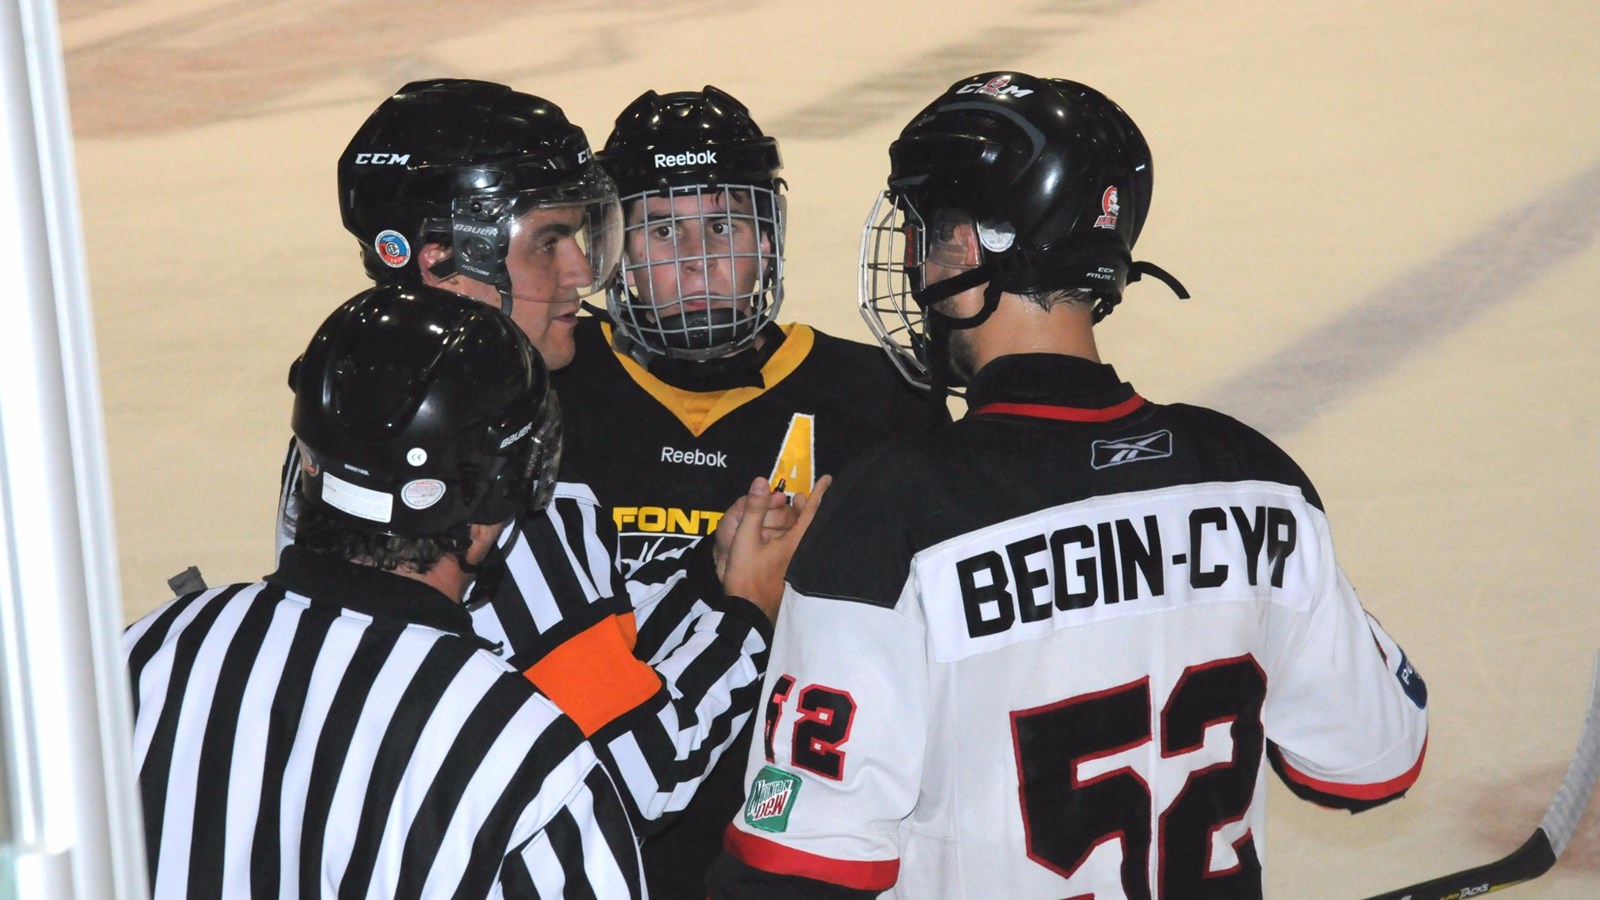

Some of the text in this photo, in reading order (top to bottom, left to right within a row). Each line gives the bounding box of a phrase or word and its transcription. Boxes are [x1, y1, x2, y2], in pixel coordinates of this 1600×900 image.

[956, 83, 1034, 98] CM
[355, 153, 410, 166] CCM
[654, 150, 717, 168] Reebok
[661, 446, 727, 469] Reebok
[768, 412, 815, 505] A
[955, 506, 1297, 639] BEGIN-CYR
[1009, 652, 1268, 900] 52
[1459, 883, 1490, 900] TACKS
